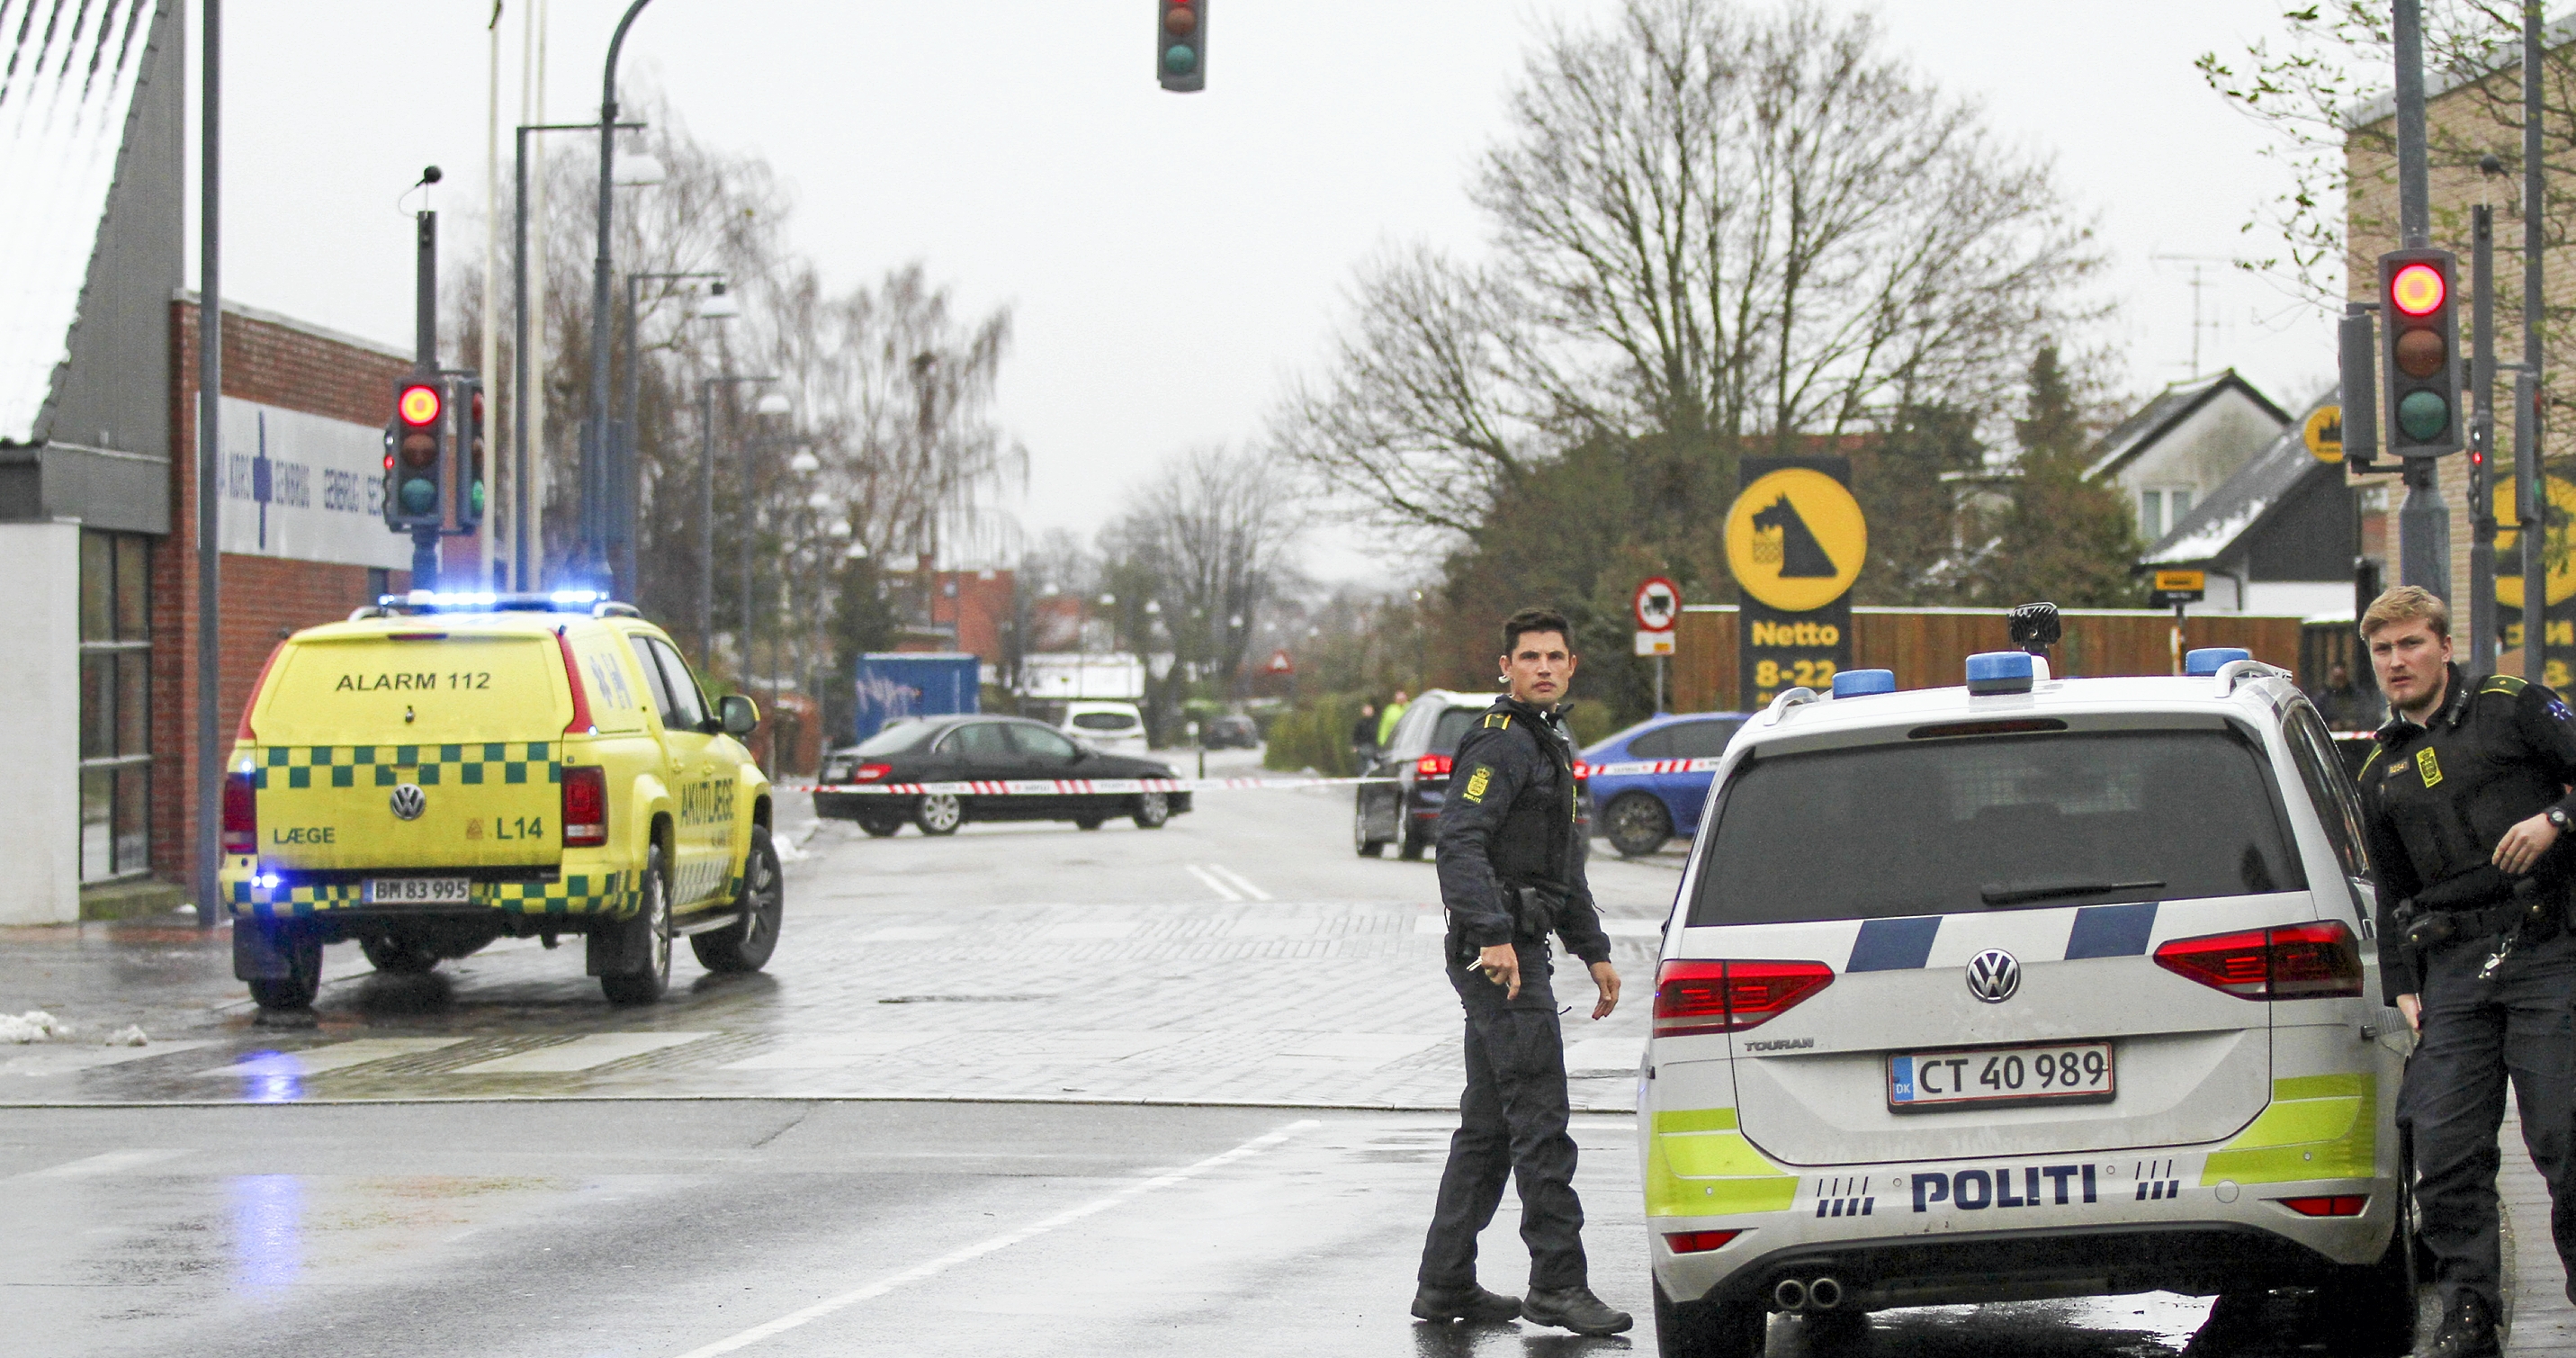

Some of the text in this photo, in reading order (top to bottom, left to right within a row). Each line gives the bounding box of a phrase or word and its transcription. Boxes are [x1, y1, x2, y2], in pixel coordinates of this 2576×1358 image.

[1752, 618, 1840, 647] Netto
[336, 671, 491, 691] ALARM 112
[1755, 660, 1836, 688] 8-22
[1463, 792, 1482, 804] POLITI
[274, 827, 335, 844] LÆGE
[497, 816, 543, 840] L14
[375, 881, 467, 899] BM 83 995
[1745, 1037, 1815, 1052] TOURAN
[1919, 1050, 2105, 1093] CT 40 989
[1896, 1083, 1911, 1095] DK
[1911, 1164, 2097, 1213] POLITI
